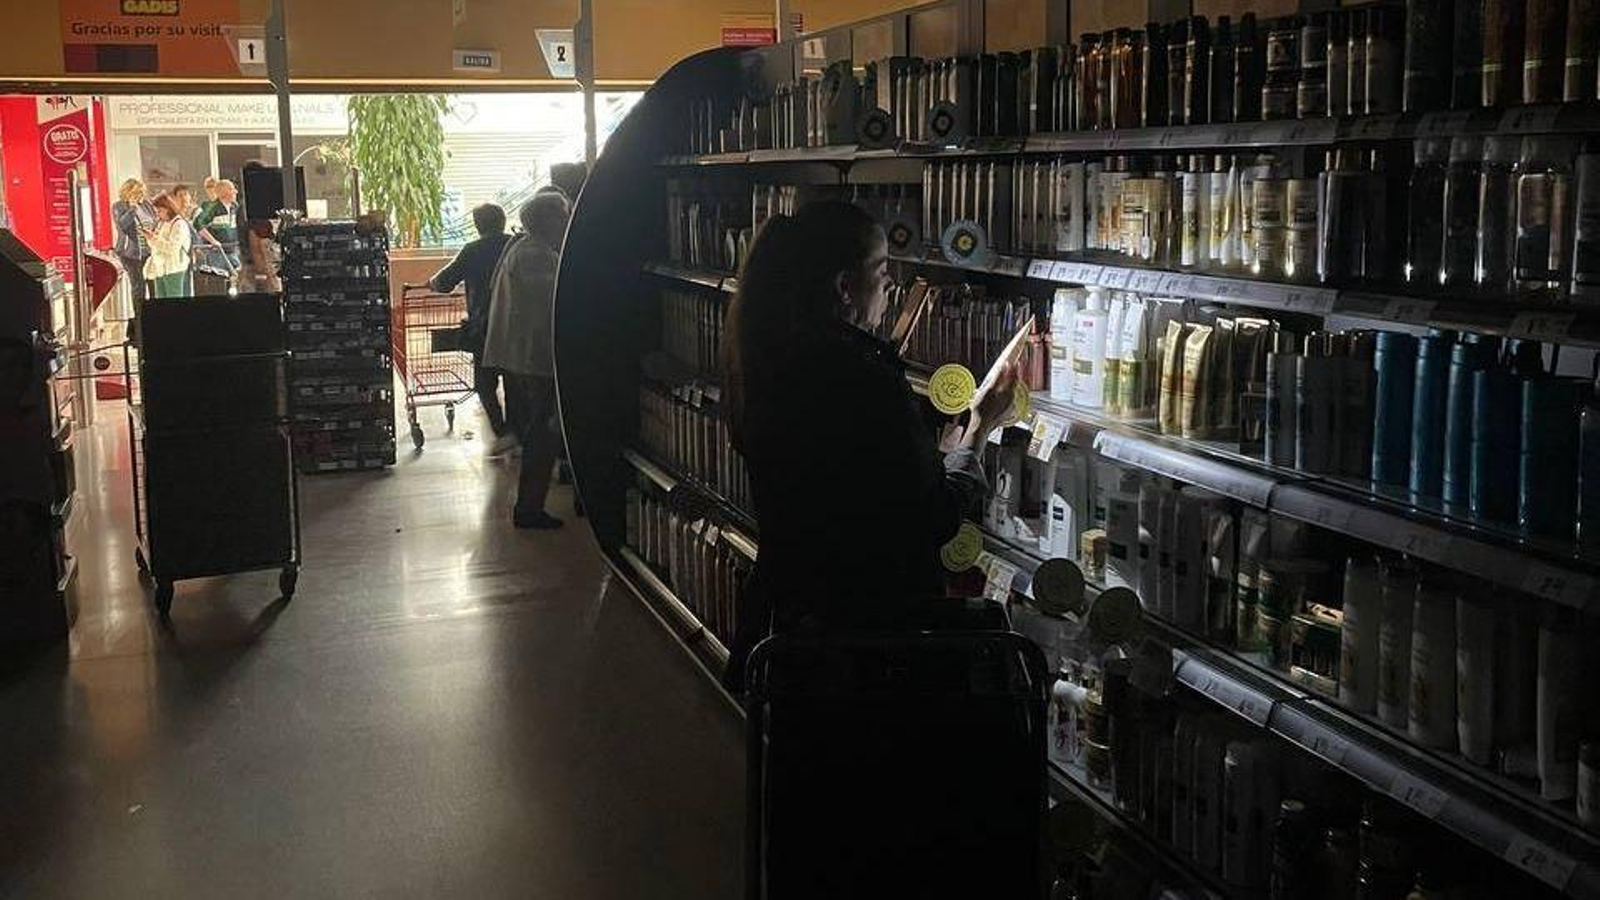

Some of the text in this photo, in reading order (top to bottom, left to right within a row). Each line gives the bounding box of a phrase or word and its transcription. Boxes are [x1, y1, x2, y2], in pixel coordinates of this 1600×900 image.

[123, 0, 177, 13] GADIS
[71, 22, 131, 36] Gracias
[133, 25, 161, 38] por
[166, 26, 185, 36] su
[557, 45, 566, 62] 2
[118, 102, 224, 115] PROFESSIONAL
[227, 102, 265, 114] MAKE
[50, 130, 80, 143] GRATIS
